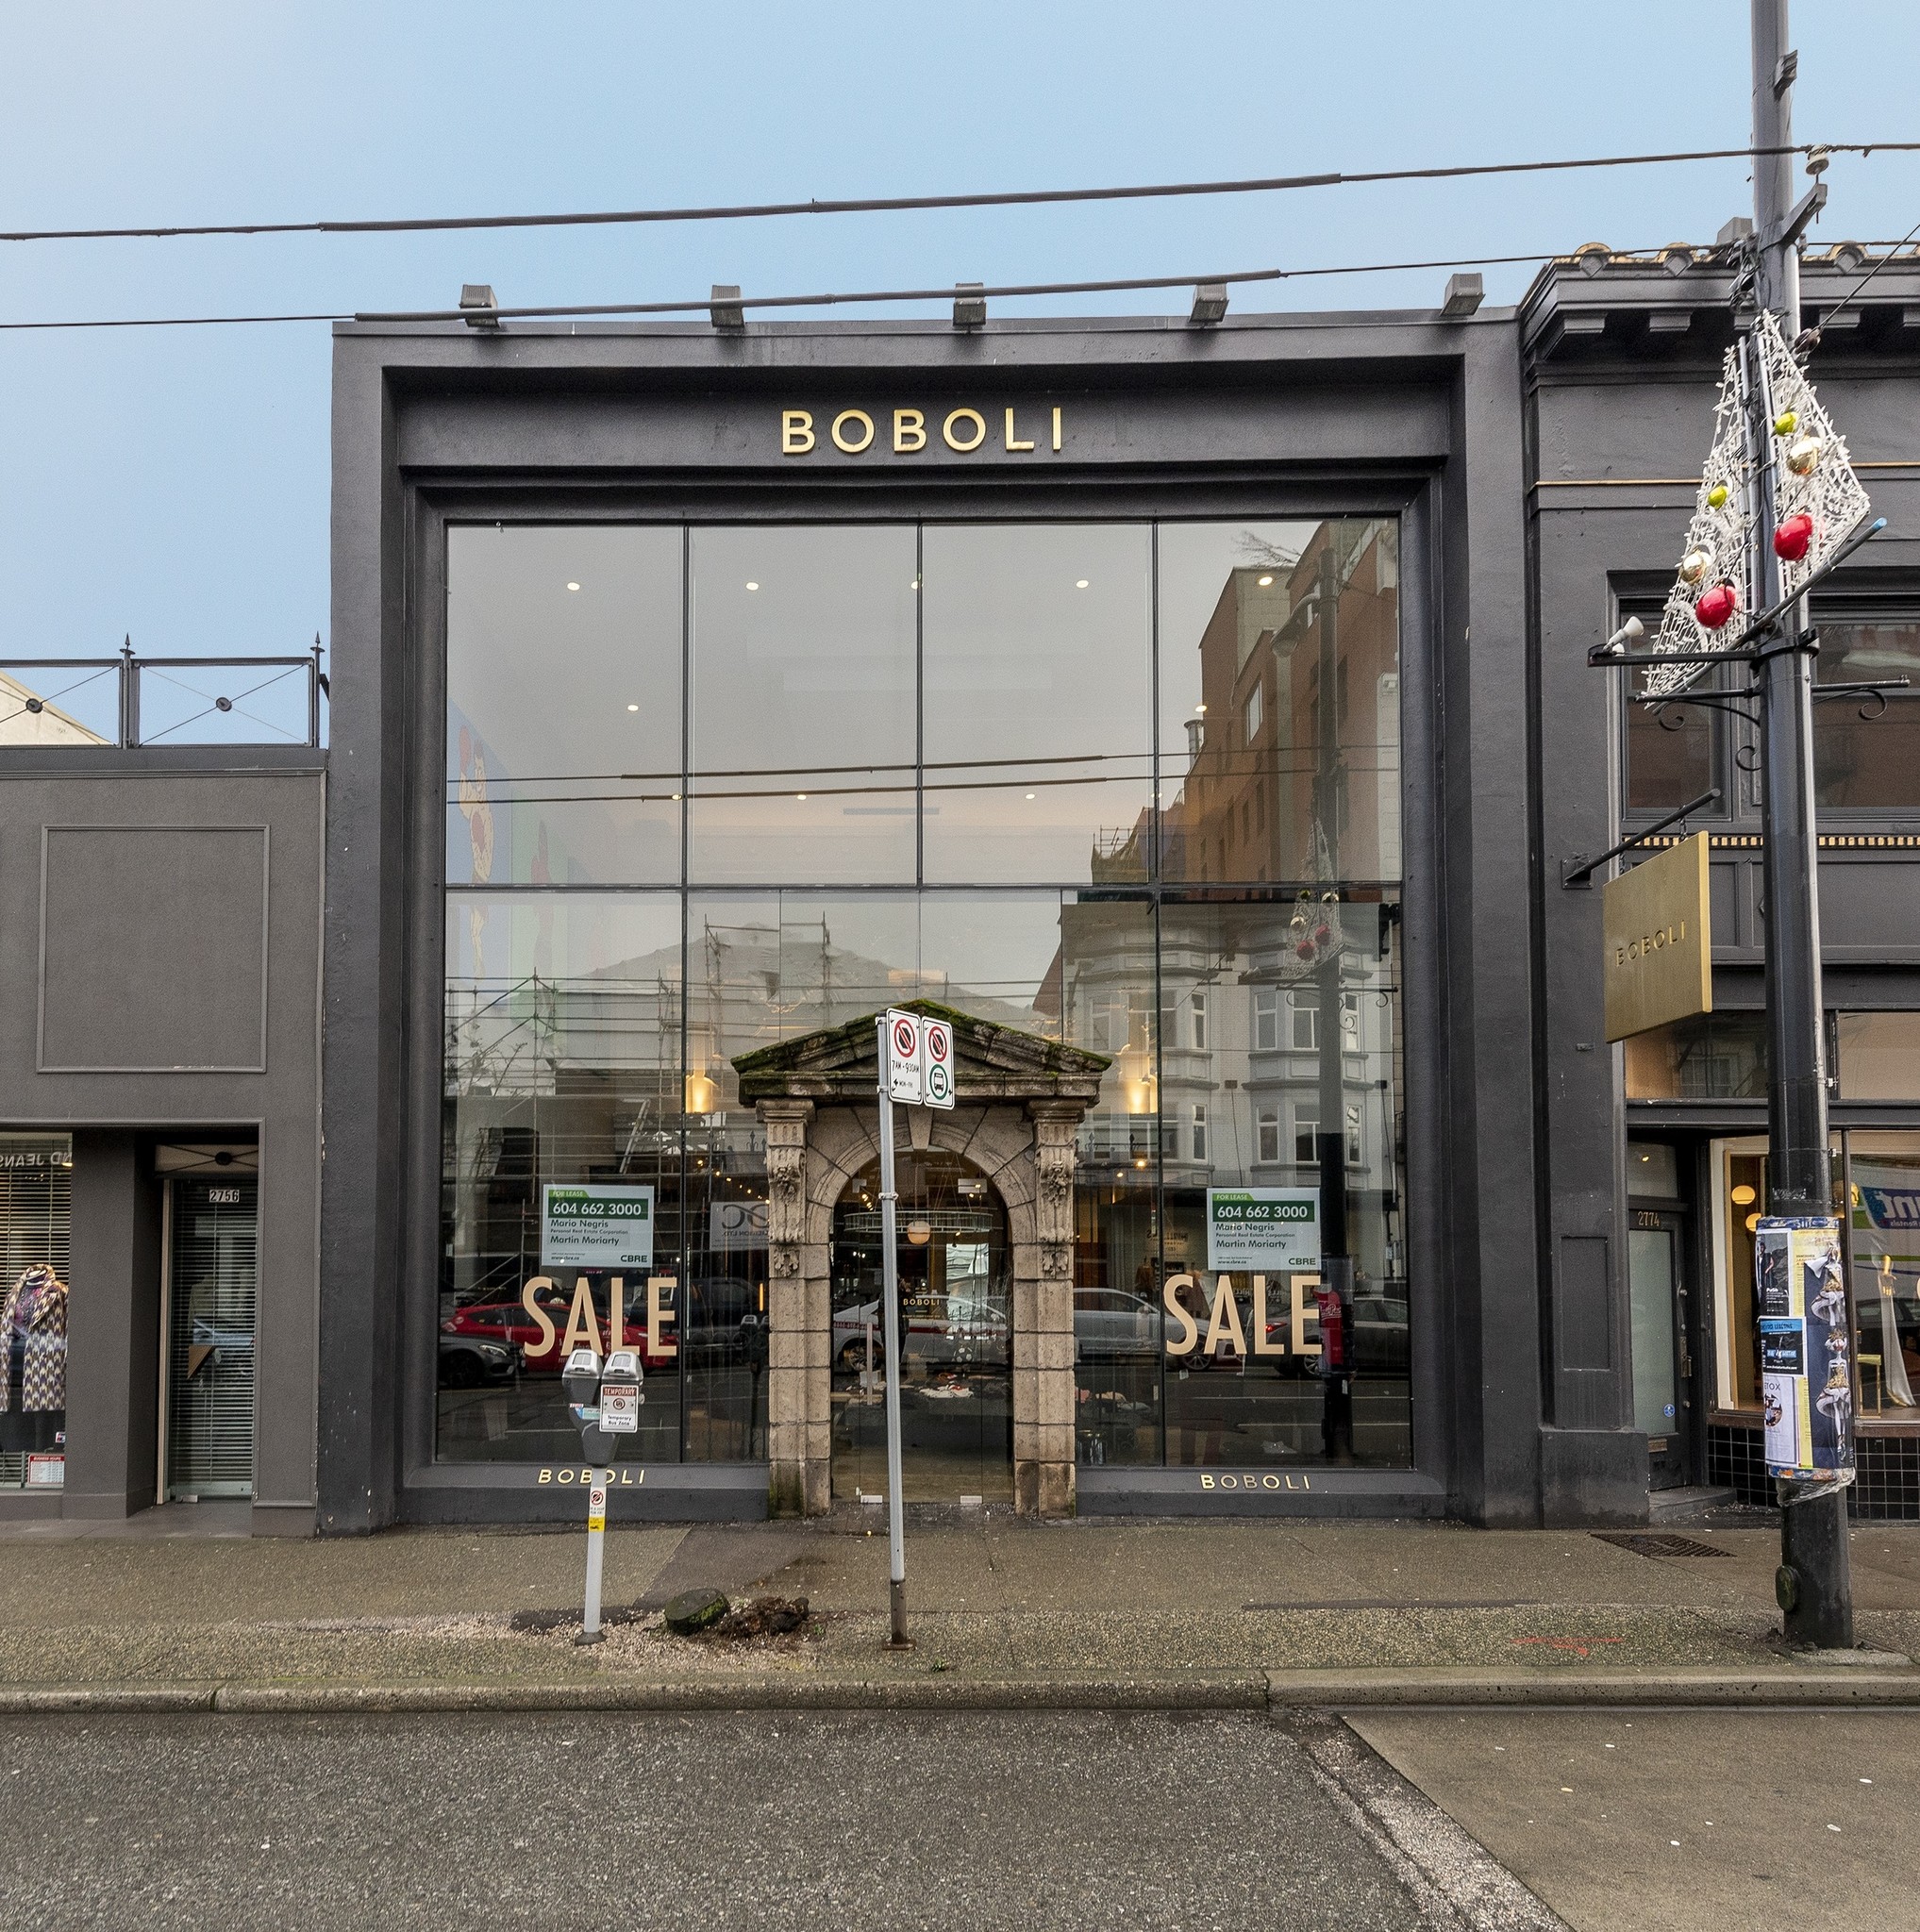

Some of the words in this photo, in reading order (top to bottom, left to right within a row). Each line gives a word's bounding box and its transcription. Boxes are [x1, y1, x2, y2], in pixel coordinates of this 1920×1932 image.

[782, 408, 1061, 454] BOBOLI
[1615, 920, 1685, 967] BOBOLI
[210, 1190, 239, 1202] 2756
[553, 1203, 577, 1215] 604
[581, 1203, 605, 1215] 662
[609, 1203, 642, 1216] 3000
[1217, 1206, 1242, 1218] 604
[1245, 1206, 1269, 1218] 662
[1274, 1206, 1308, 1218] 3000
[550, 1219, 576, 1227] Mario
[579, 1220, 609, 1229] Negris
[1637, 1210, 1660, 1226] 2774
[1215, 1223, 1242, 1231] Mario
[1245, 1223, 1275, 1232] Negris
[581, 1236, 619, 1246] Moriarty
[1216, 1240, 1245, 1248] Martin
[1248, 1240, 1286, 1250] Moriarty
[522, 1275, 677, 1357] SALE
[1163, 1274, 1323, 1356] SALE
[604, 1387, 636, 1396] TEMPORARY
[538, 1469, 645, 1485] BOBOLI
[1200, 1474, 1311, 1490] BOBOLI
